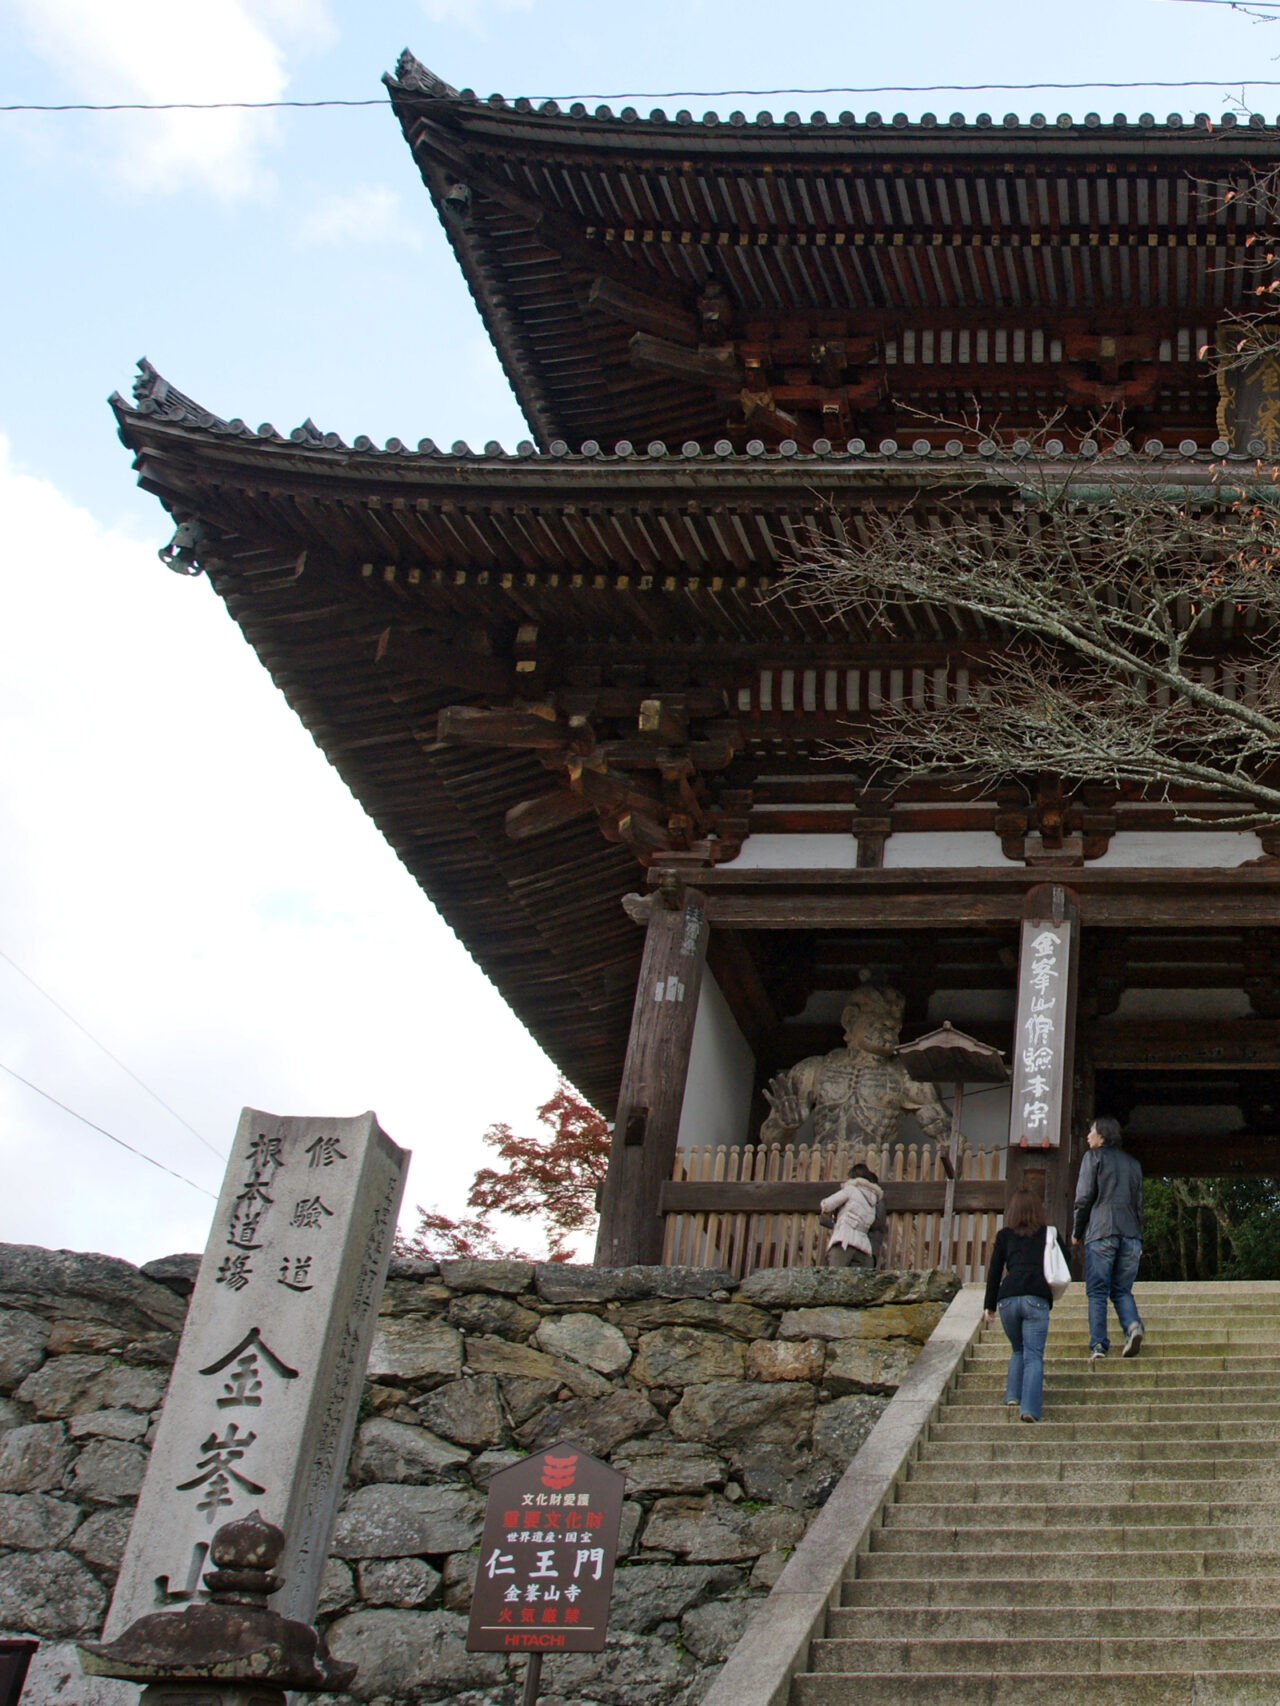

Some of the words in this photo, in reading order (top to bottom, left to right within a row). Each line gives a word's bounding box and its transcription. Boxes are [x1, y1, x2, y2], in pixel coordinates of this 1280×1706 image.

[521, 1493, 590, 1506] 文化財愛護
[503, 1510, 604, 1529] 重要文化財
[485, 1548, 605, 1580] 仁王門
[504, 1584, 581, 1602] 金峯山寺
[497, 1607, 580, 1623] 火気厳禁
[504, 1633, 566, 1646] HITACHI
